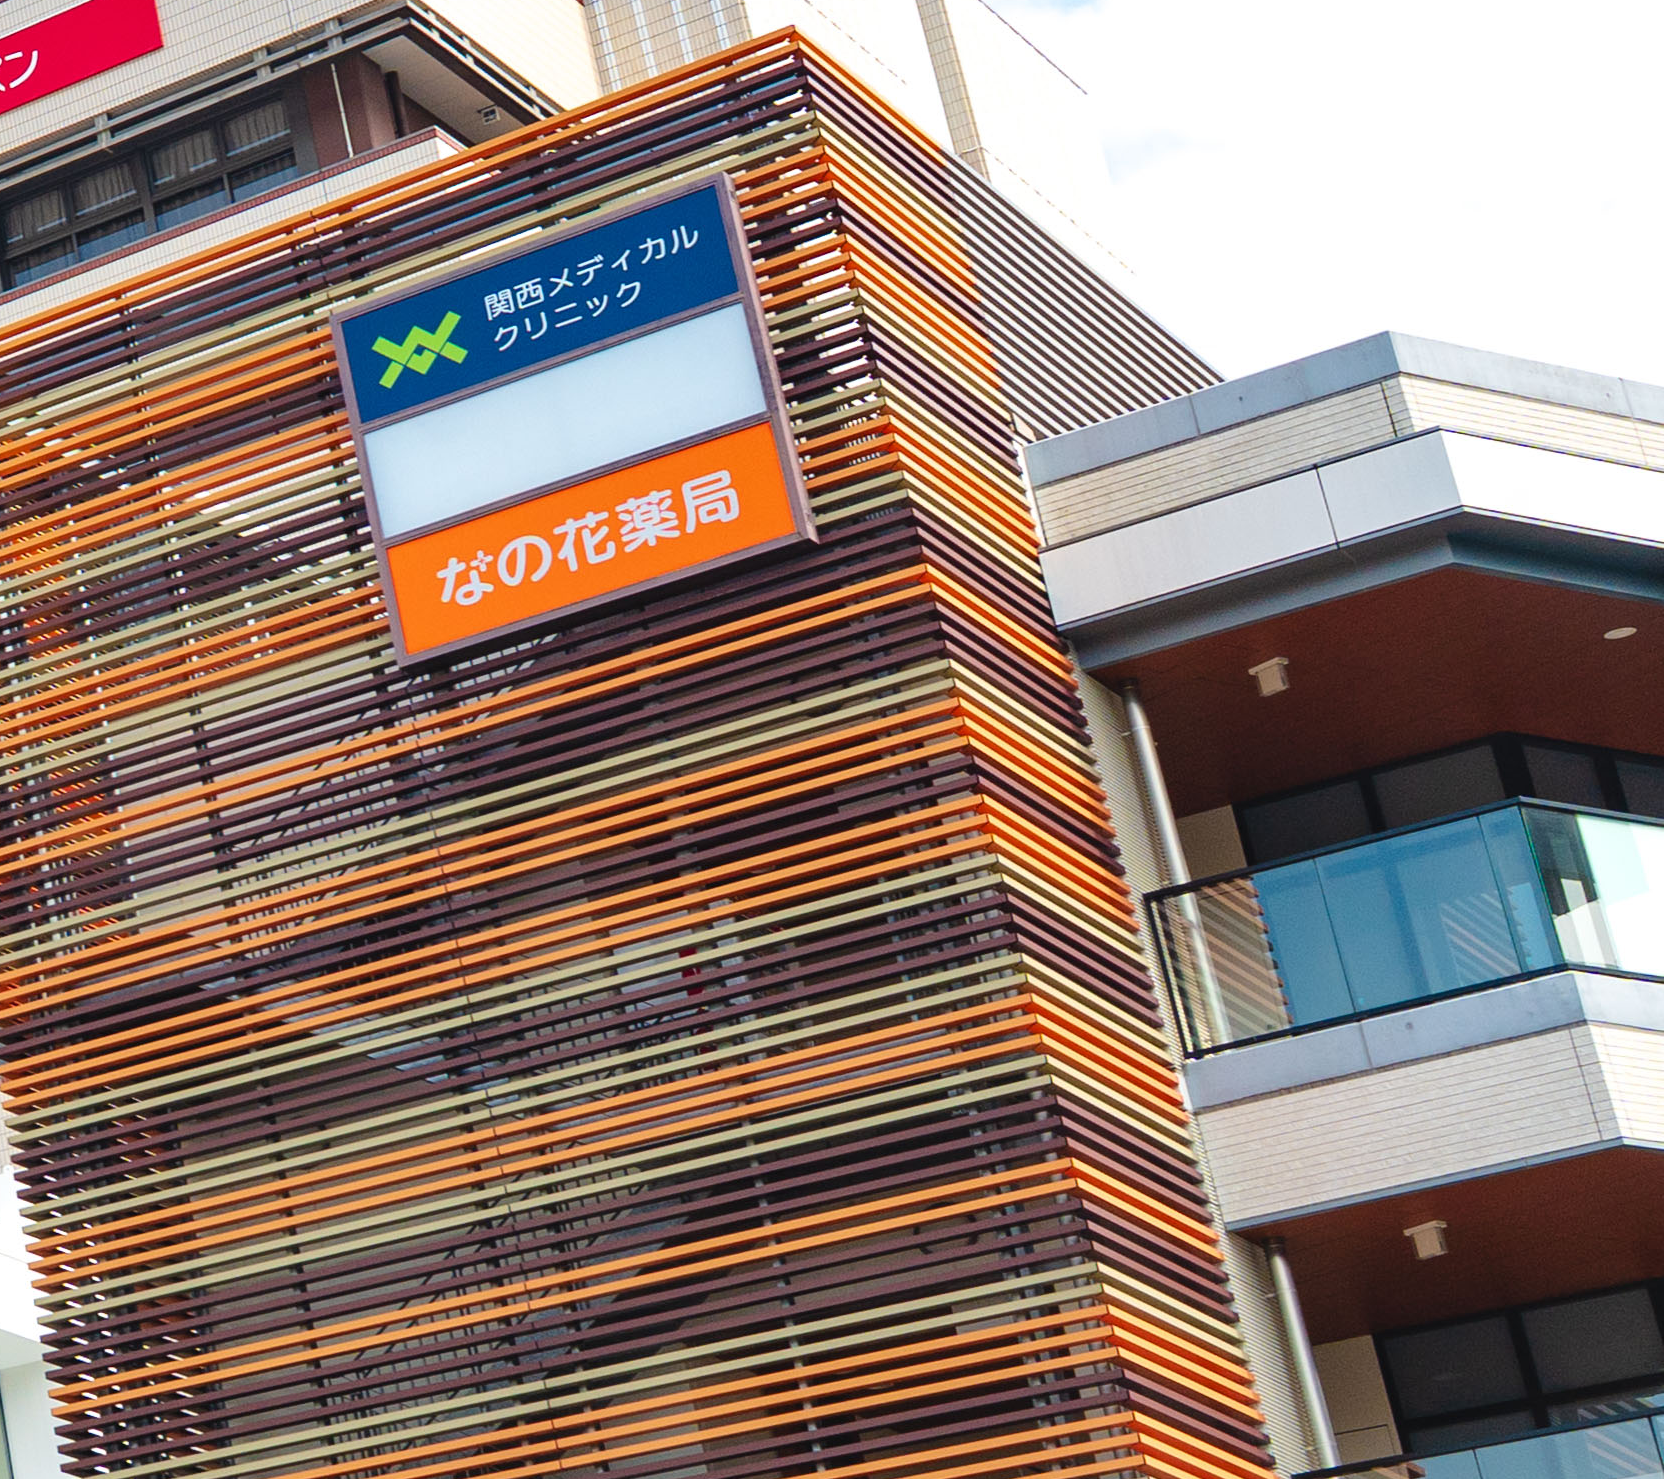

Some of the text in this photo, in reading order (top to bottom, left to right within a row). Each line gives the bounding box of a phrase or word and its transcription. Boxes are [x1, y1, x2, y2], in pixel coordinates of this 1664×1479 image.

[483, 223, 700, 322] 関西メディカル
[493, 279, 643, 352] クリニック
[436, 469, 741, 606] なの花薬局
